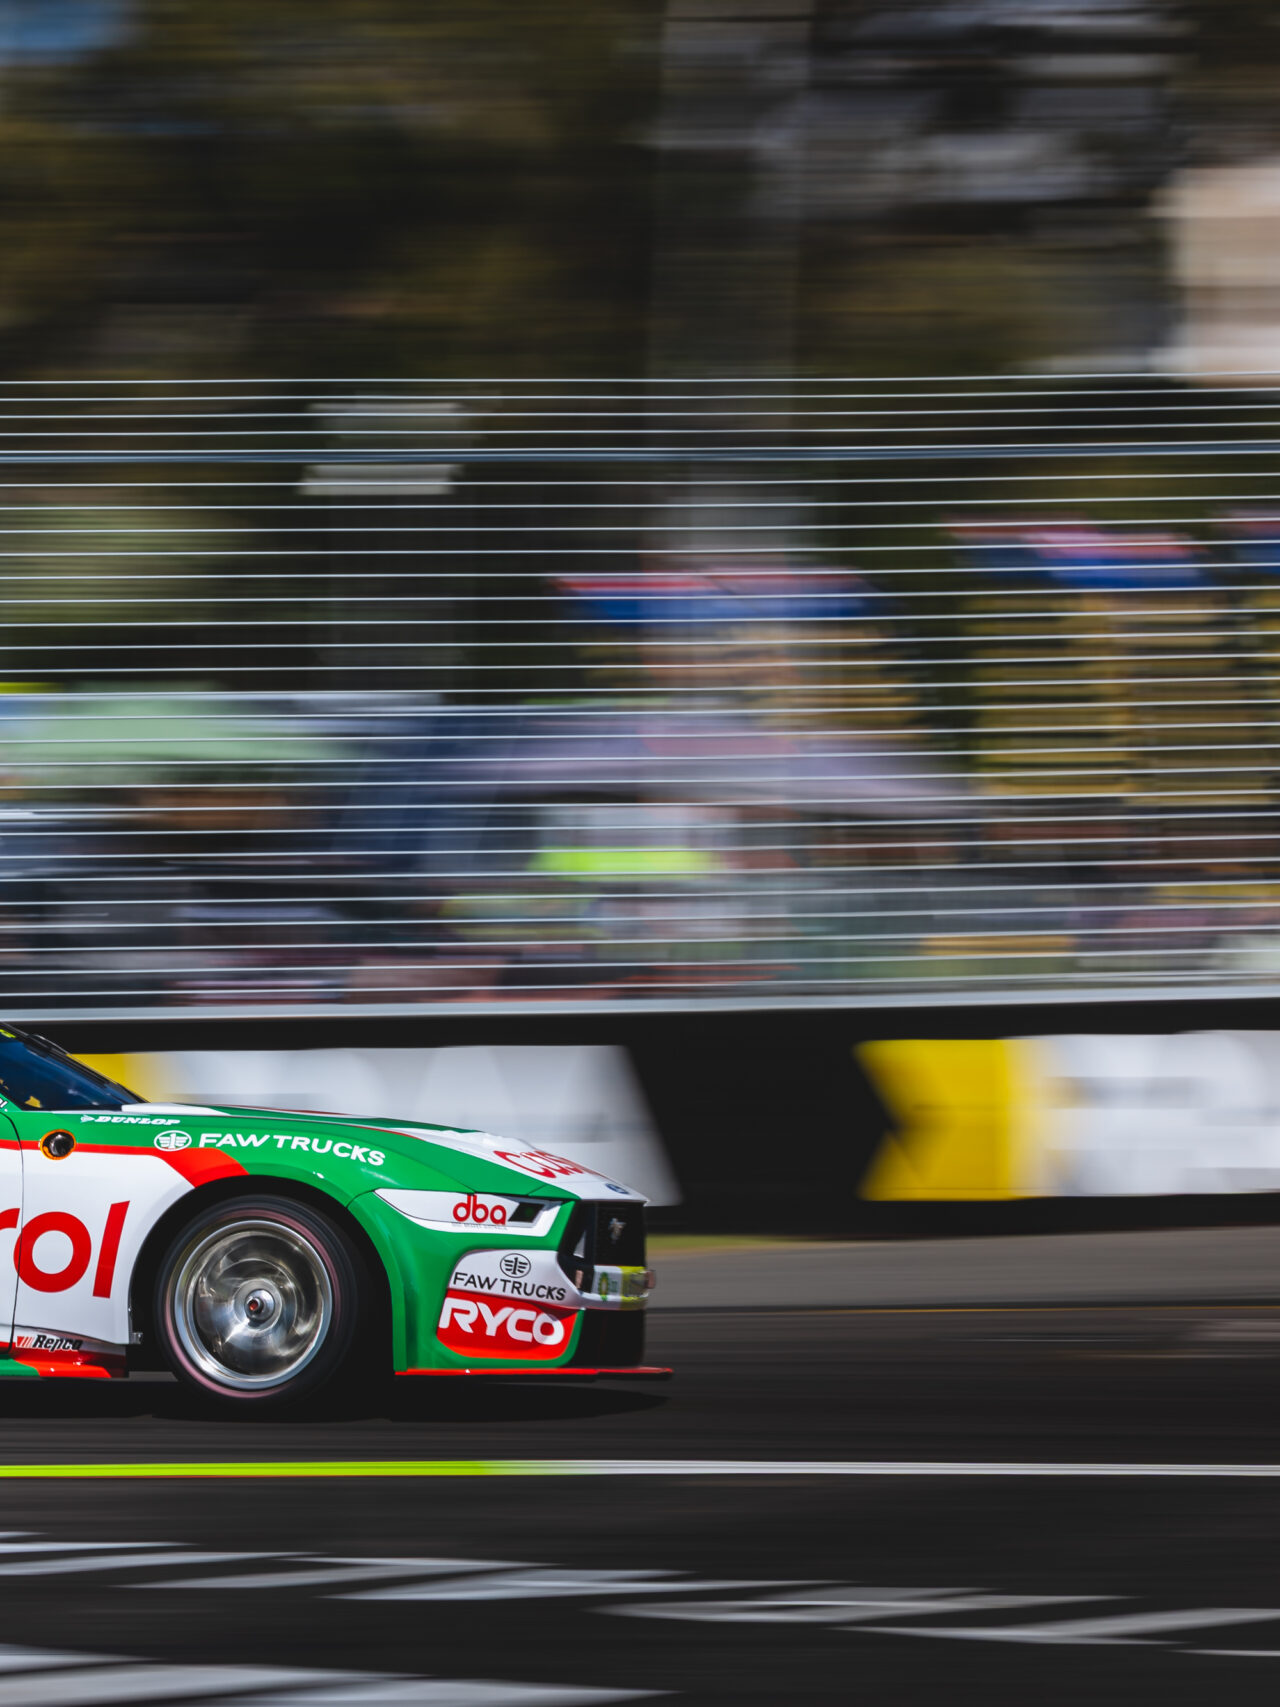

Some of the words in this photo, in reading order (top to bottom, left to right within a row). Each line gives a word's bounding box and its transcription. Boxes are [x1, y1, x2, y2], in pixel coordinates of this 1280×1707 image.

[94, 1116, 181, 1125] DUNLOP
[198, 1133, 271, 1148] FAW
[273, 1134, 387, 1166] TRUCKS
[452, 1194, 507, 1225] dba
[453, 1272, 498, 1290] FAW
[499, 1278, 566, 1301] TRUCKS
[438, 1297, 565, 1346] RYCO
[32, 1334, 84, 1352] Repco
